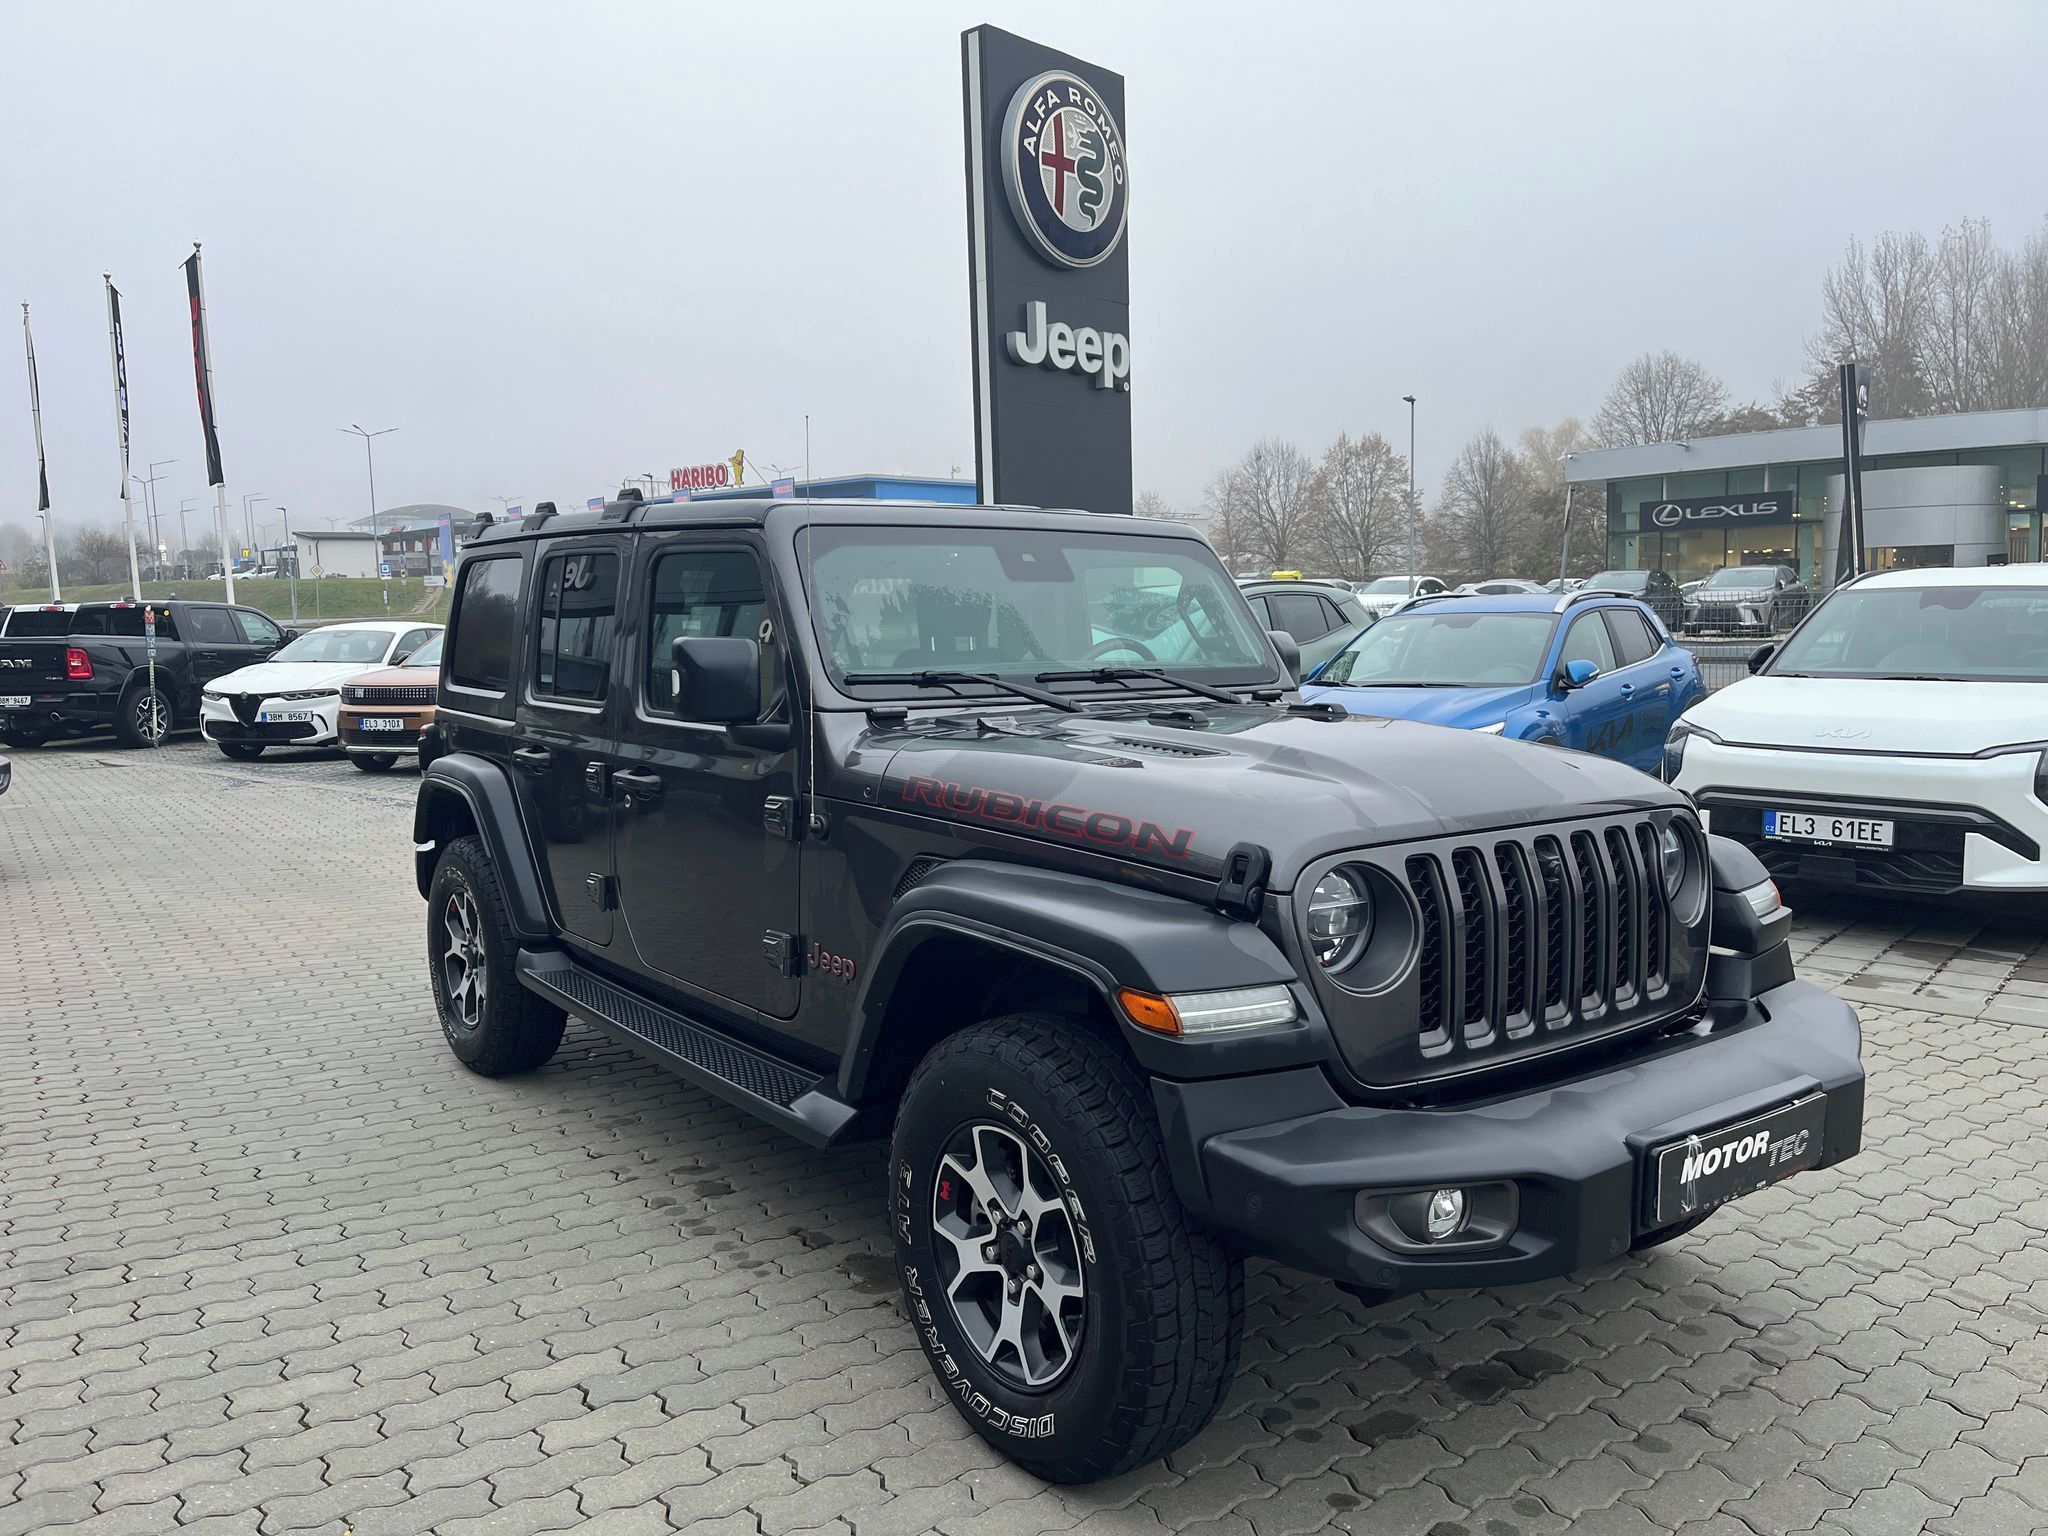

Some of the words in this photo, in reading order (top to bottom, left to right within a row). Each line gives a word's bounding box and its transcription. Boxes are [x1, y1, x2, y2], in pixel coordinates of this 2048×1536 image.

[1023, 88, 1061, 157] ALFA
[1067, 86, 1124, 186] ROMEO
[1006, 300, 1130, 390] Jeep
[670, 463, 728, 490] HARIBO
[1685, 501, 1778, 519] LEXUS
[0, 659, 32, 668] AM
[268, 713, 283, 721] 3BM
[287, 712, 308, 721] 8567
[364, 720, 378, 728] EL3
[902, 775, 1196, 860] RUBICON
[1779, 814, 1816, 835] EL3
[1831, 819, 1883, 842] 61EE
[807, 942, 856, 985] Jeep
[986, 1087, 1096, 1265] COOPER
[1680, 1130, 1770, 1184] MOTOR
[1769, 1129, 1810, 1168] TEC
[905, 1265, 1057, 1439] DISCOVERER
